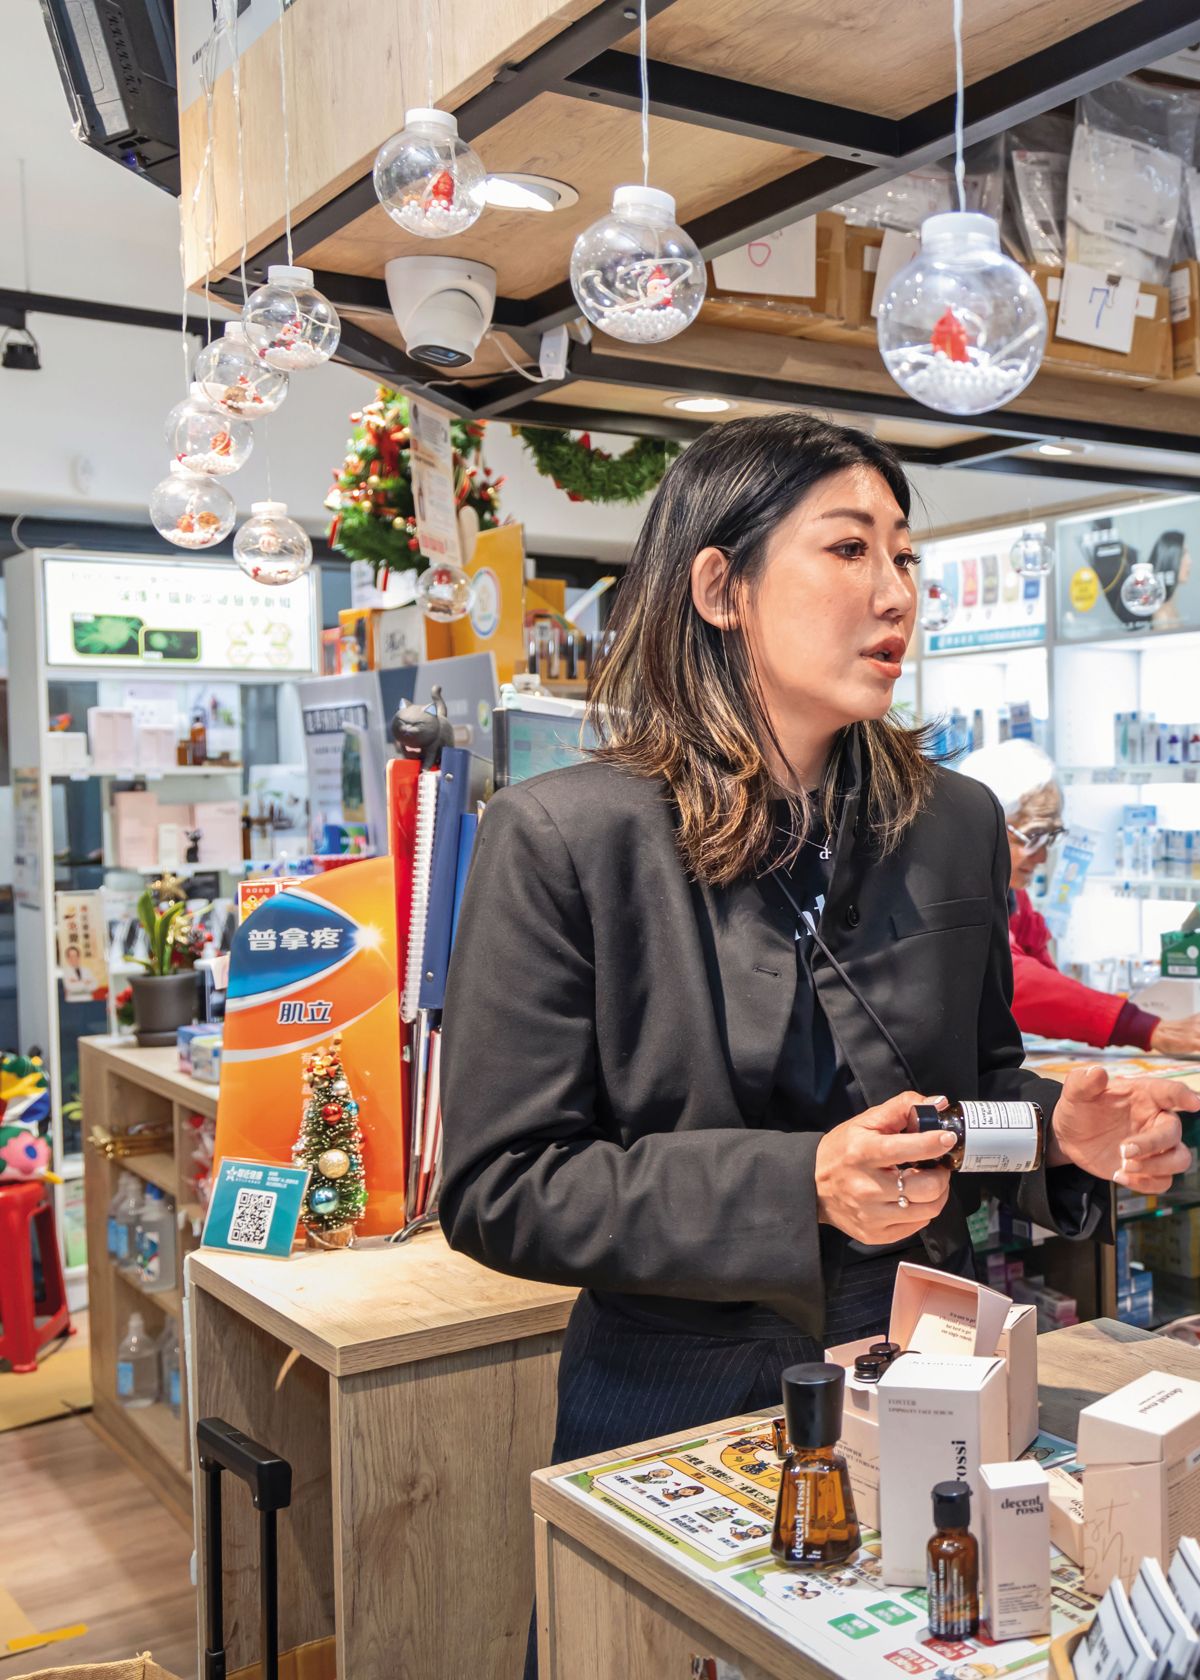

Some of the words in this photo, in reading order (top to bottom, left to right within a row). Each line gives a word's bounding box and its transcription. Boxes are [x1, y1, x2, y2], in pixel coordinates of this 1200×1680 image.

[1089, 287, 1110, 329] 7
[247, 927, 343, 951] 普拿疼
[277, 1000, 333, 1025] 肌立
[951, 1440, 967, 1482] ossi
[1000, 1496, 1043, 1510] decent
[1015, 1504, 1045, 1516] rossi
[791, 1514, 804, 1559] decent
